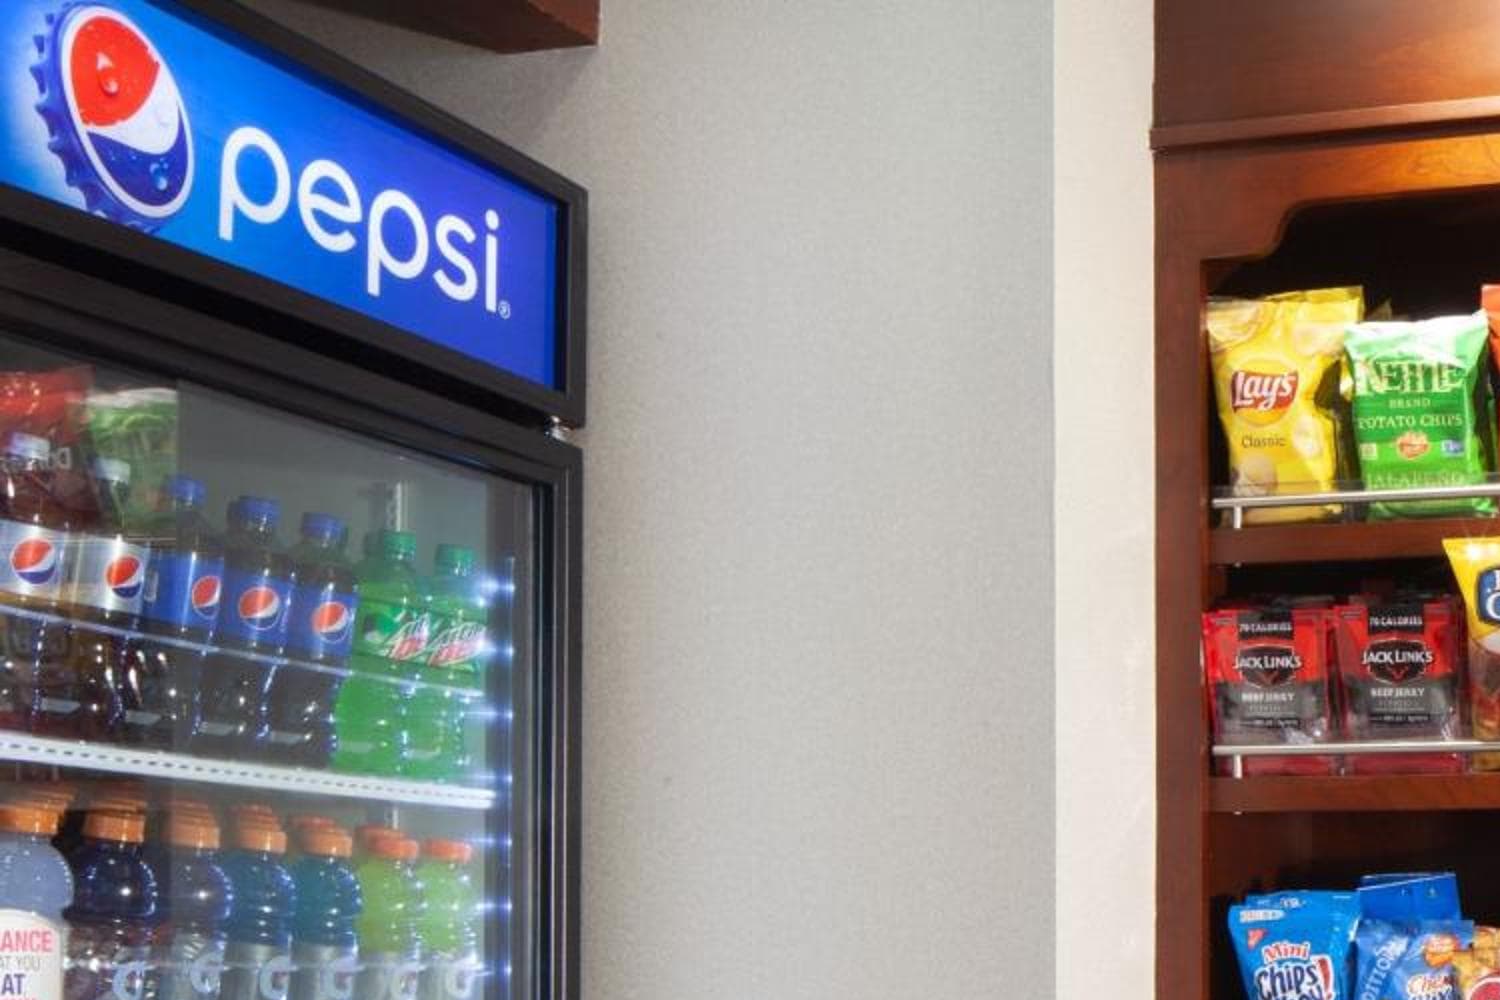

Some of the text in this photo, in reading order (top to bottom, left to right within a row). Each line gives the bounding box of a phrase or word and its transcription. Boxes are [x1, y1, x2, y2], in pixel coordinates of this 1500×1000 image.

[219, 127, 499, 312] pepsi
[1420, 414, 1463, 428] CHIPS
[1241, 434, 1287, 448] Classic
[1234, 655, 1263, 669] JACK
[1362, 651, 1393, 664] JACK
[1263, 942, 1310, 961] Mini
[1, 974, 26, 995] AT
